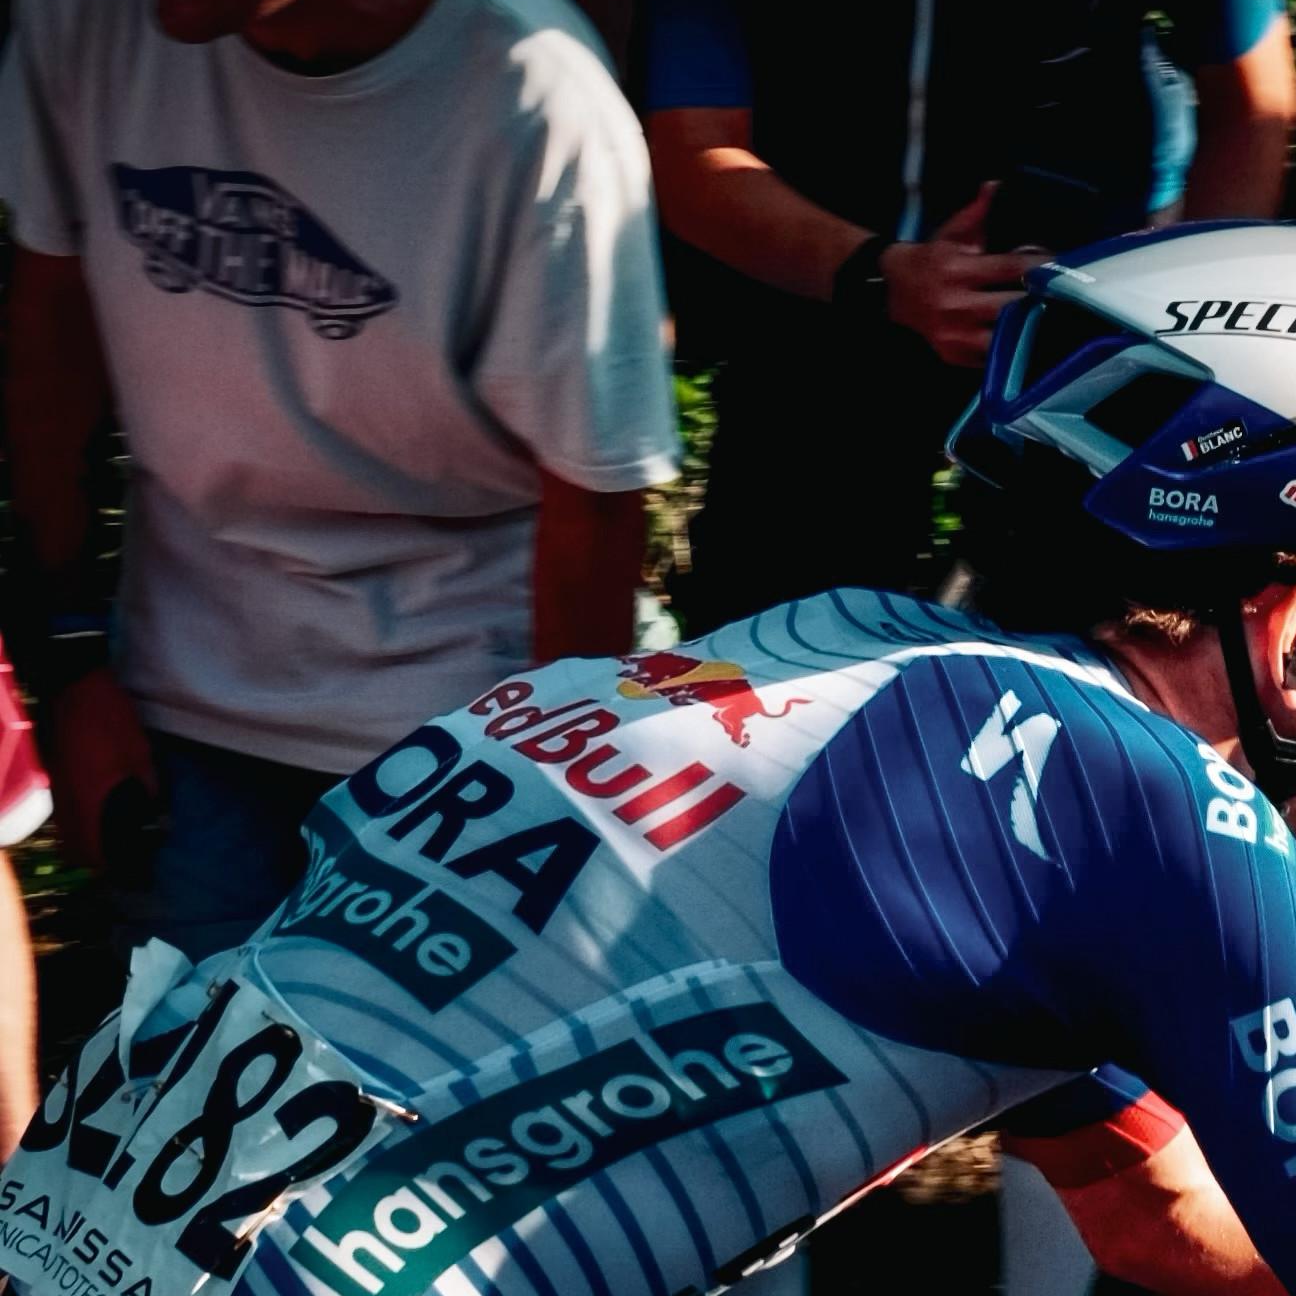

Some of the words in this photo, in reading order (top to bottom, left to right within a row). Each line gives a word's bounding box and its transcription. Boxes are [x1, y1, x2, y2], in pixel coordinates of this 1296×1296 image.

[1200, 426, 1243, 455] BLANC
[1148, 487, 1219, 515] BORA
[347, 724, 602, 936] ORA
[303, 1027, 795, 1296] hansgrohe
